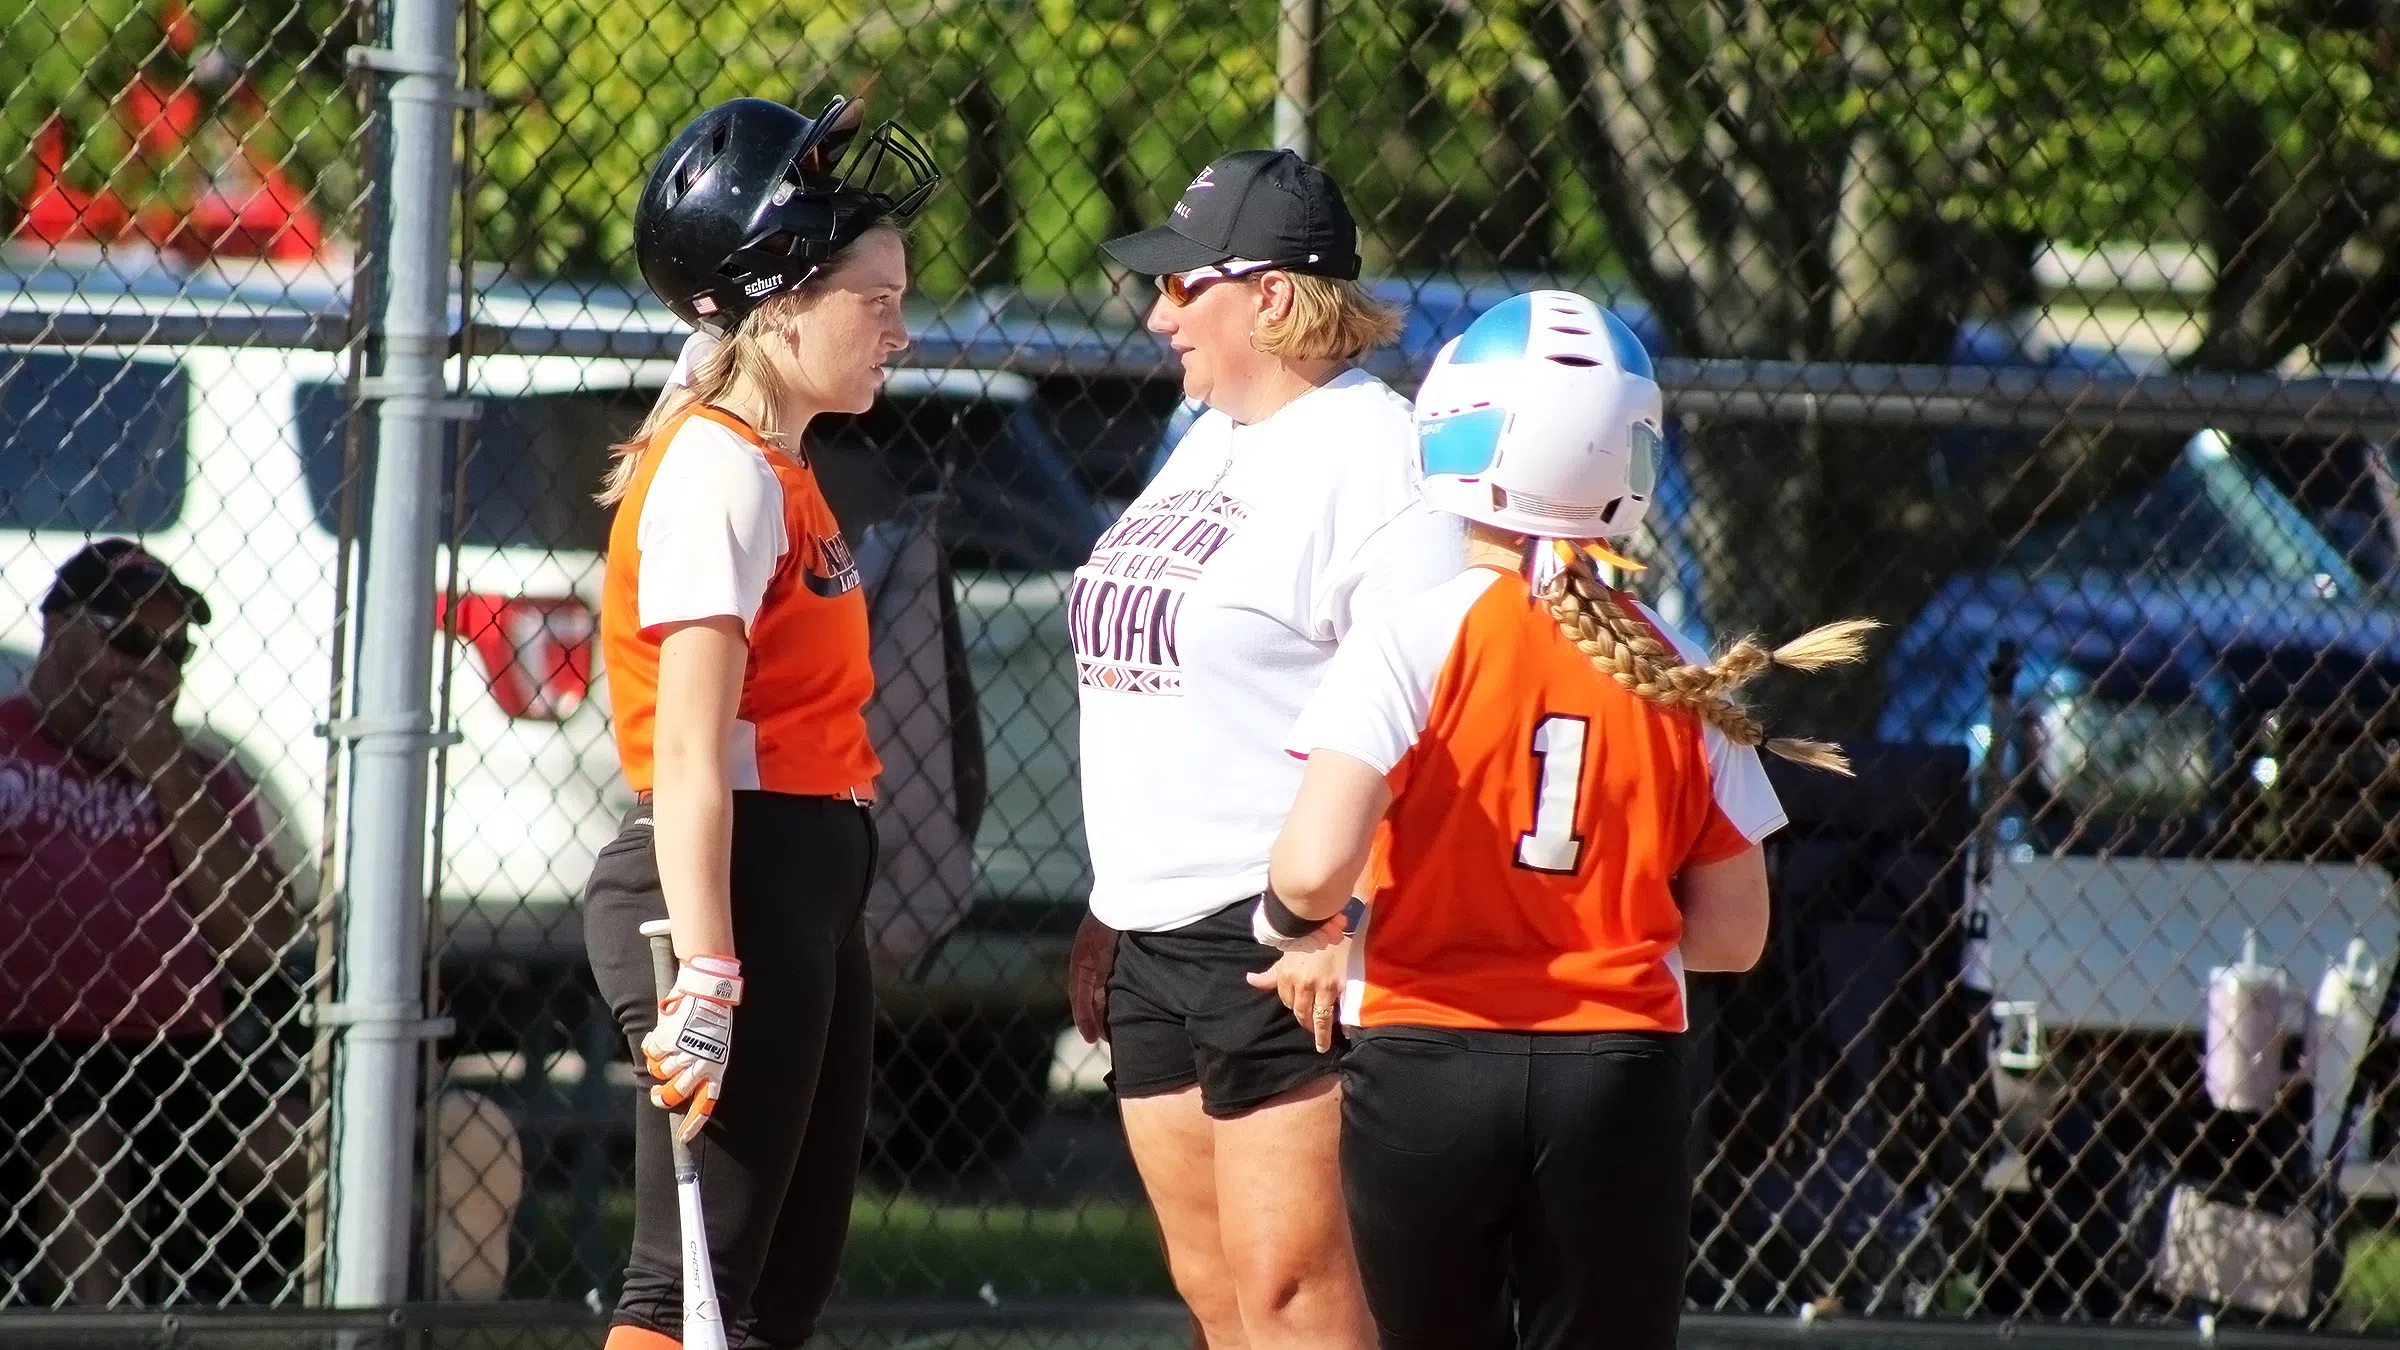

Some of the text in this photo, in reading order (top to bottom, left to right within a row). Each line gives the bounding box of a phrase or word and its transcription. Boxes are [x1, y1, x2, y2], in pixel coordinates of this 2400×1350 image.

[744, 273, 783, 295] schutt
[1171, 518, 1235, 566] DAY
[1102, 551, 1173, 580] TO BE AN
[1069, 577, 1185, 666] NDIAN
[1512, 711, 1590, 877] 1
[682, 1035, 725, 1059] franklin
